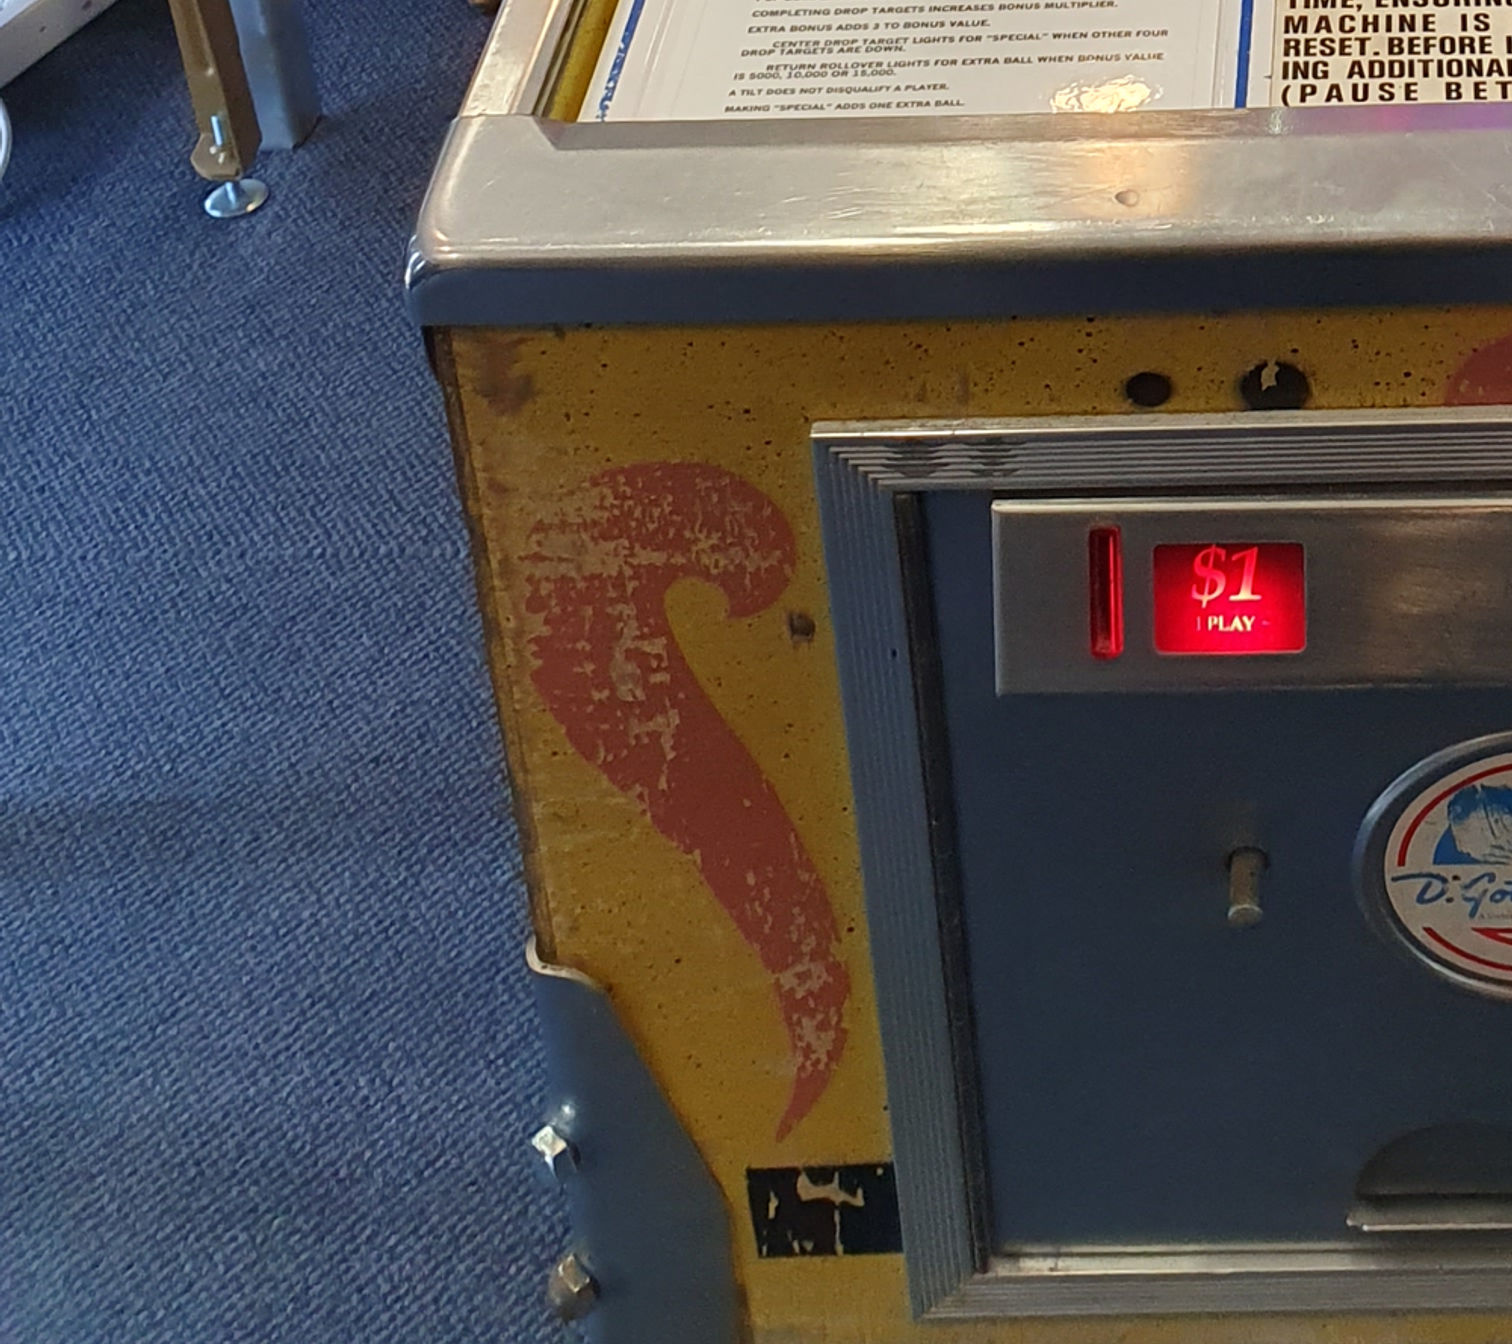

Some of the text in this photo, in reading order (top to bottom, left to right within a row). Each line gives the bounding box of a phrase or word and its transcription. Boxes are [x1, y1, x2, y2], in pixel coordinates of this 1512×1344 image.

[1283, 13, 1437, 35] MACHINE
[1461, 13, 1491, 32] IS
[1387, 36, 1494, 56] BEFORE
[1282, 60, 1329, 80] ING
[740, 88, 763, 96] TILT
[766, 88, 796, 96] DOES
[799, 87, 823, 95] NOT
[826, 85, 891, 94] DISQUALIFY
[894, 84, 902, 92] A
[1281, 81, 1420, 108] (PAUSE
[1191, 544, 1263, 609] $1
[1207, 615, 1256, 632] PLAY
